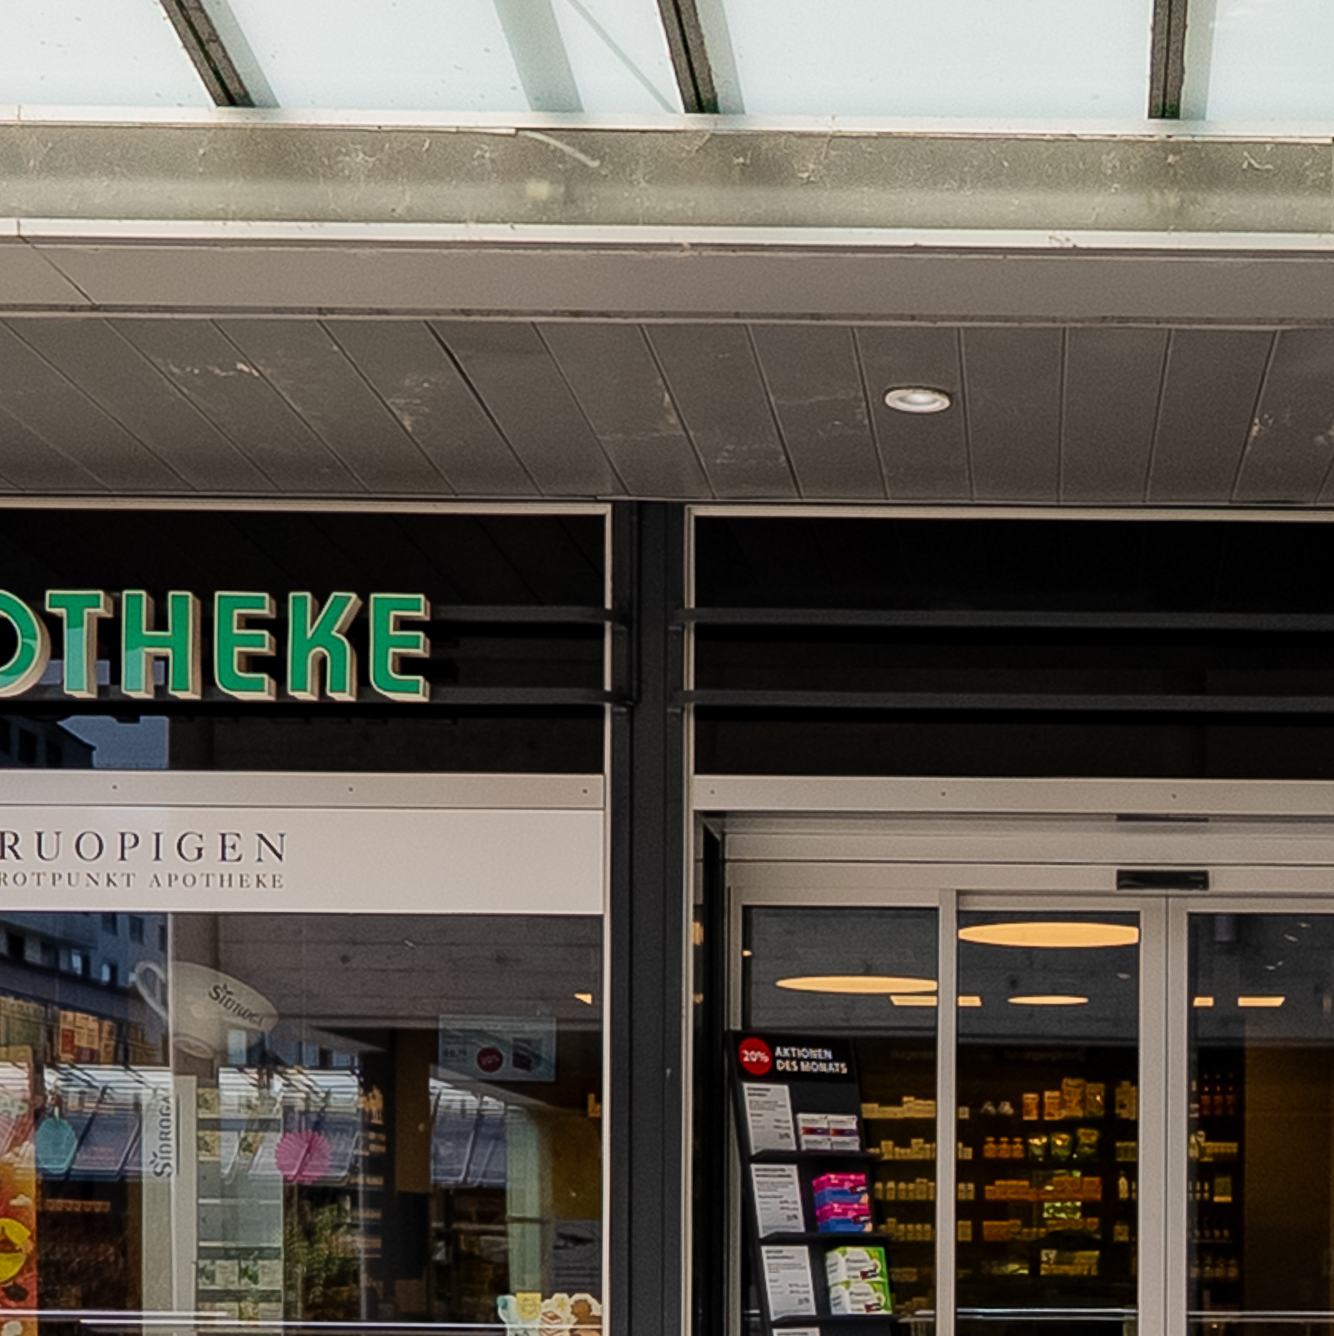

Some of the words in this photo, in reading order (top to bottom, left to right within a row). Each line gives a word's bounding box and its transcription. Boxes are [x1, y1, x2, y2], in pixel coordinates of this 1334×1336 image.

[149, 872, 284, 889] APOTHEKE
[742, 1049, 769, 1063] 20%
[775, 1046, 833, 1059] AKTIONEN
[776, 1059, 798, 1072] DES
[800, 1061, 848, 1074] MONATS
